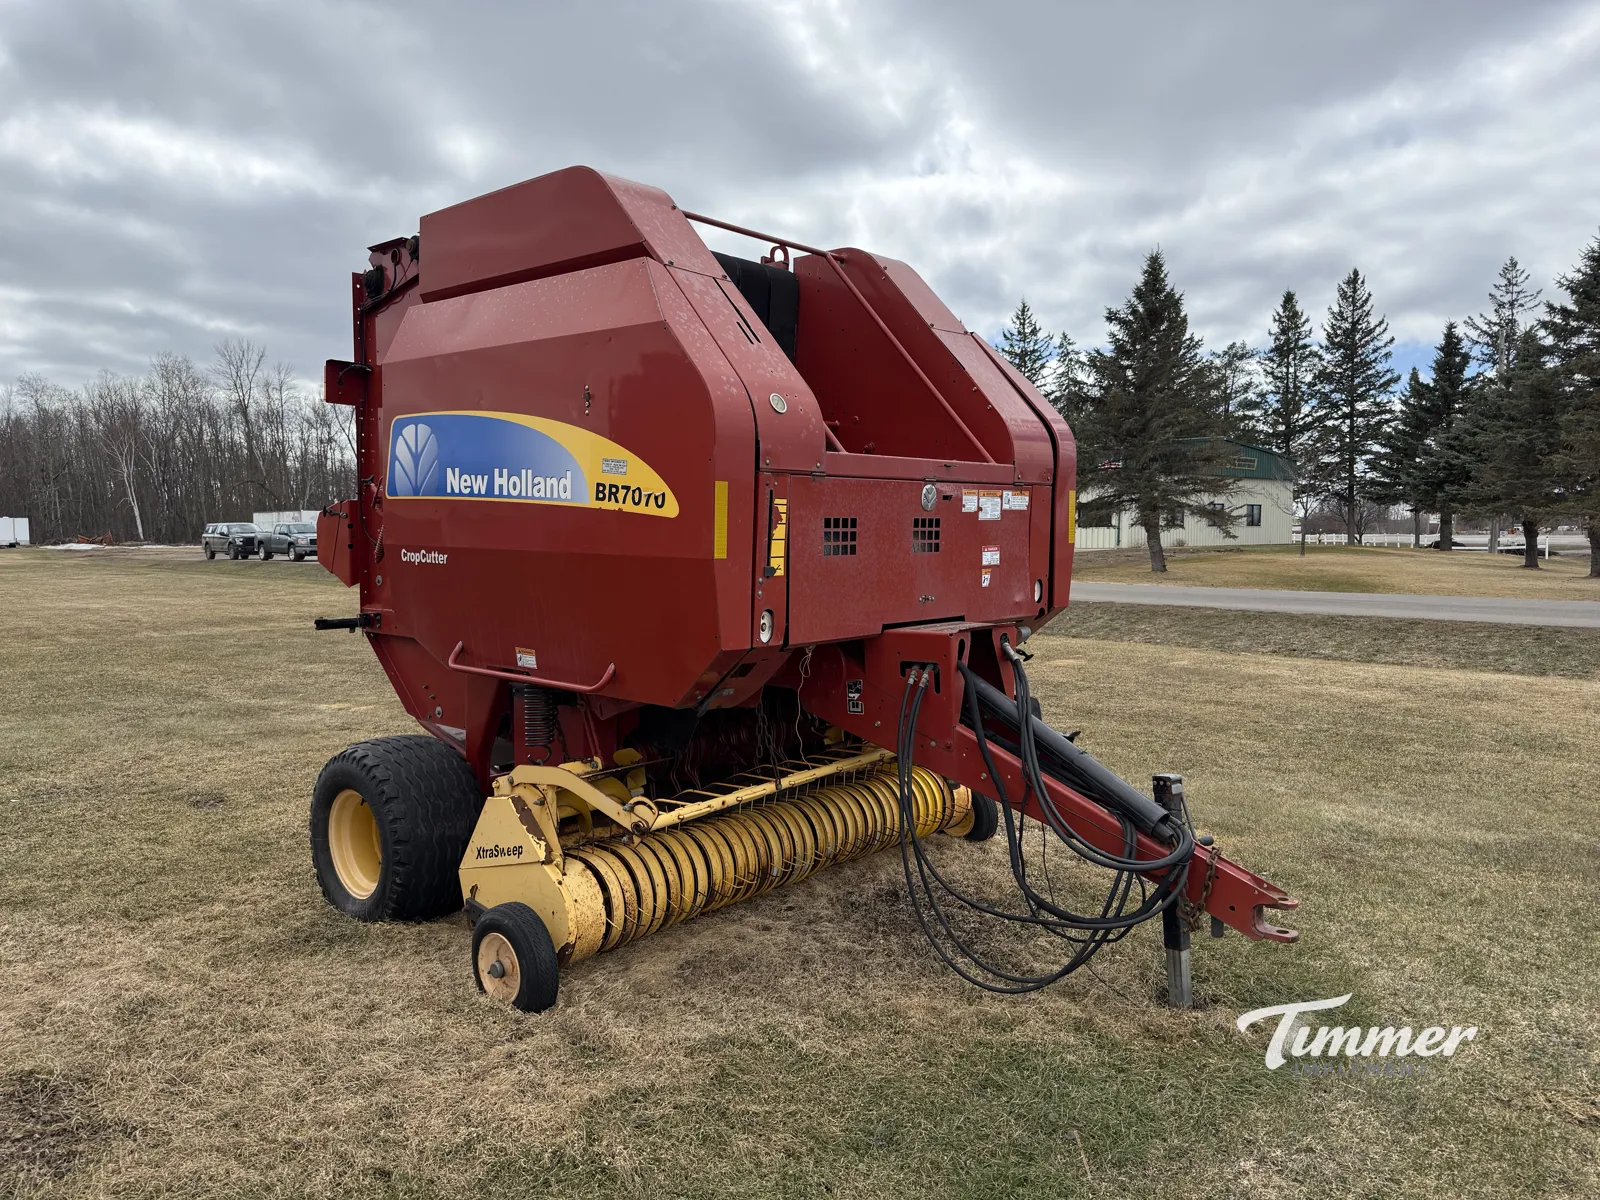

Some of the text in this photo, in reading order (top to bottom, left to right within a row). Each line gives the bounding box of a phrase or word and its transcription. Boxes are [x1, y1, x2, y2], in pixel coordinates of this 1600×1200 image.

[446, 467, 572, 500] New Holland
[594, 482, 666, 509] BR7070
[401, 548, 448, 566] CropCutter
